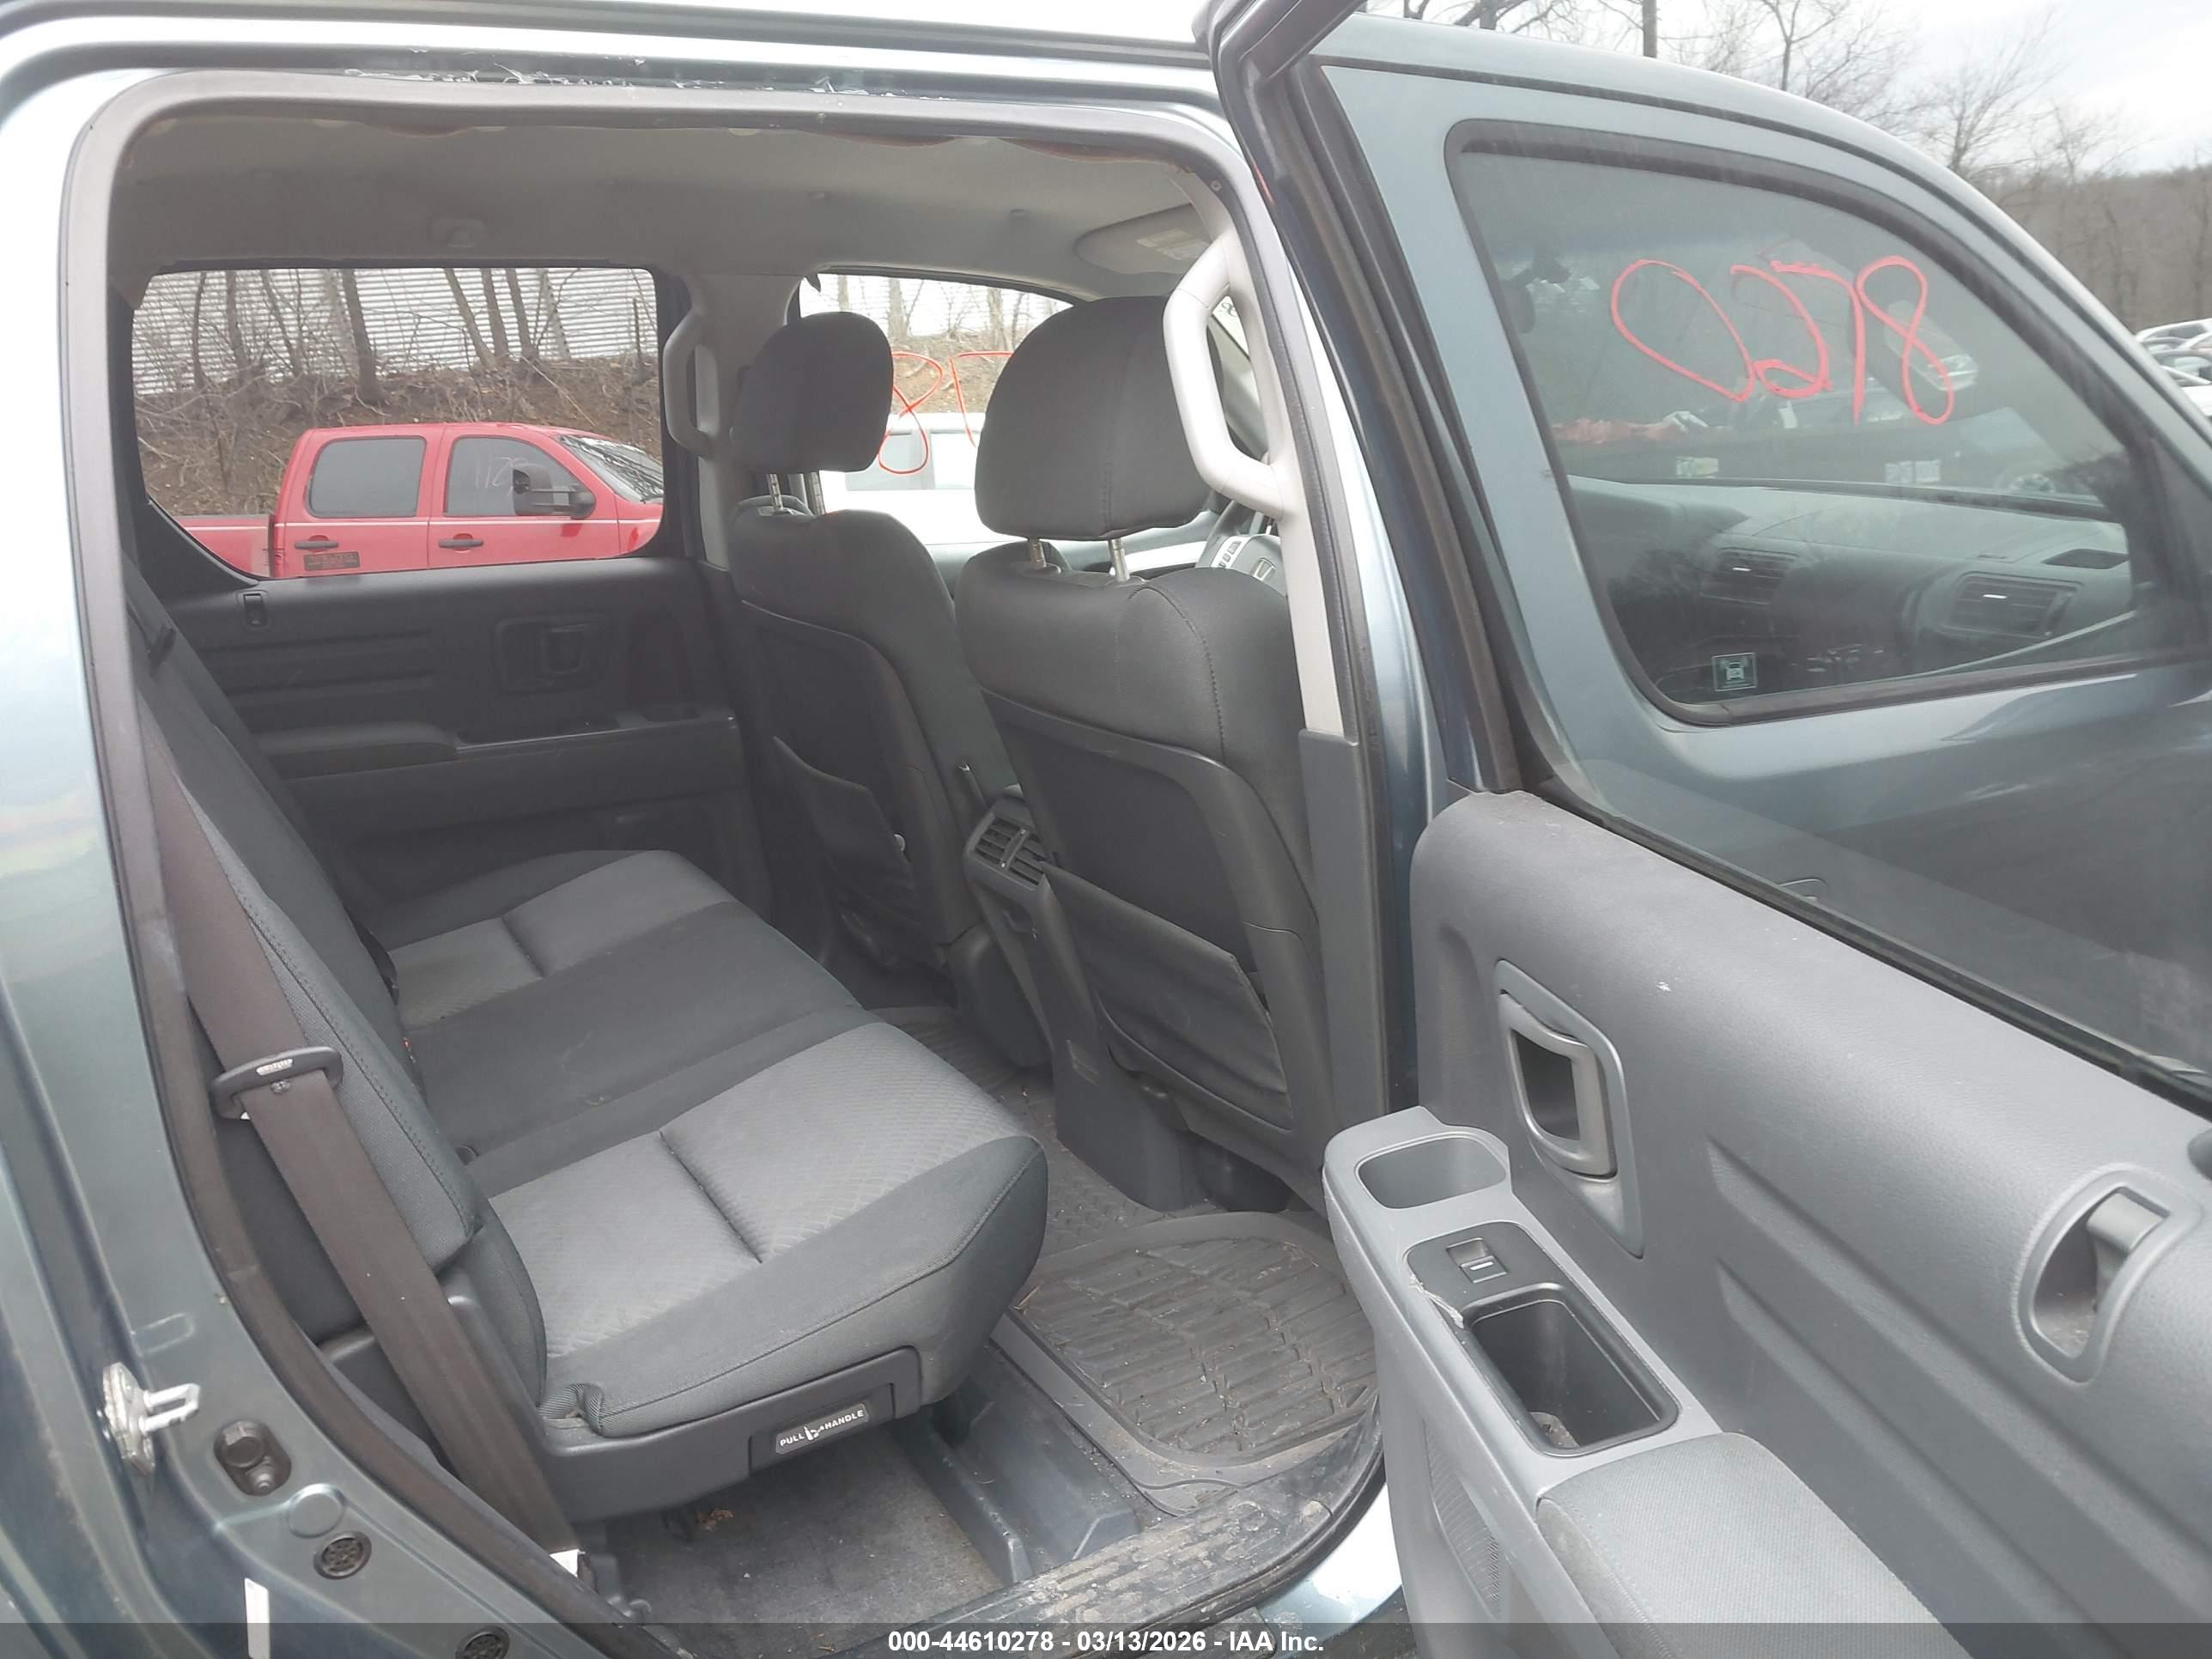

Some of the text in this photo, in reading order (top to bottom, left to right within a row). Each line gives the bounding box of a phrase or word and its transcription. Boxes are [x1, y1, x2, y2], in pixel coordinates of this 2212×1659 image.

[1611, 256, 1954, 425] 0278
[780, 1410, 864, 1446] PULL HANDLE
